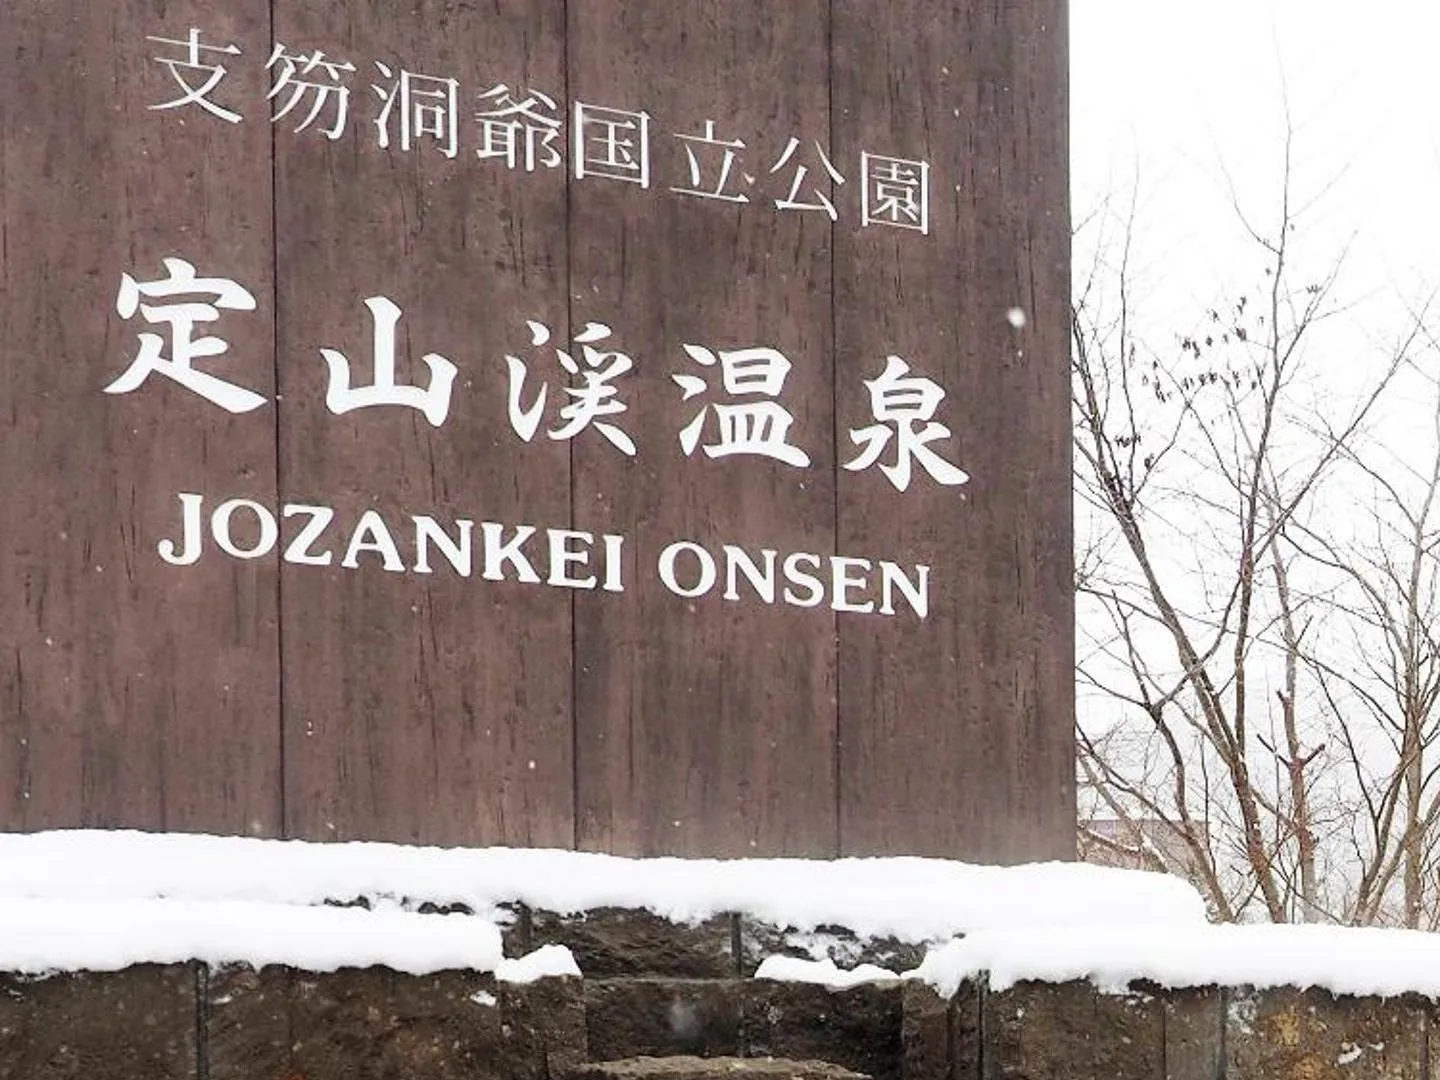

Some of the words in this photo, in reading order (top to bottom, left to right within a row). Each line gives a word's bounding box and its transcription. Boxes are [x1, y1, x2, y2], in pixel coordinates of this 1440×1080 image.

[146, 28, 931, 236] 支笏洞爺国立公園
[103, 258, 971, 492] 定山渓温泉
[157, 493, 625, 593] JOZANKEI
[658, 541, 931, 619] ONSEN
